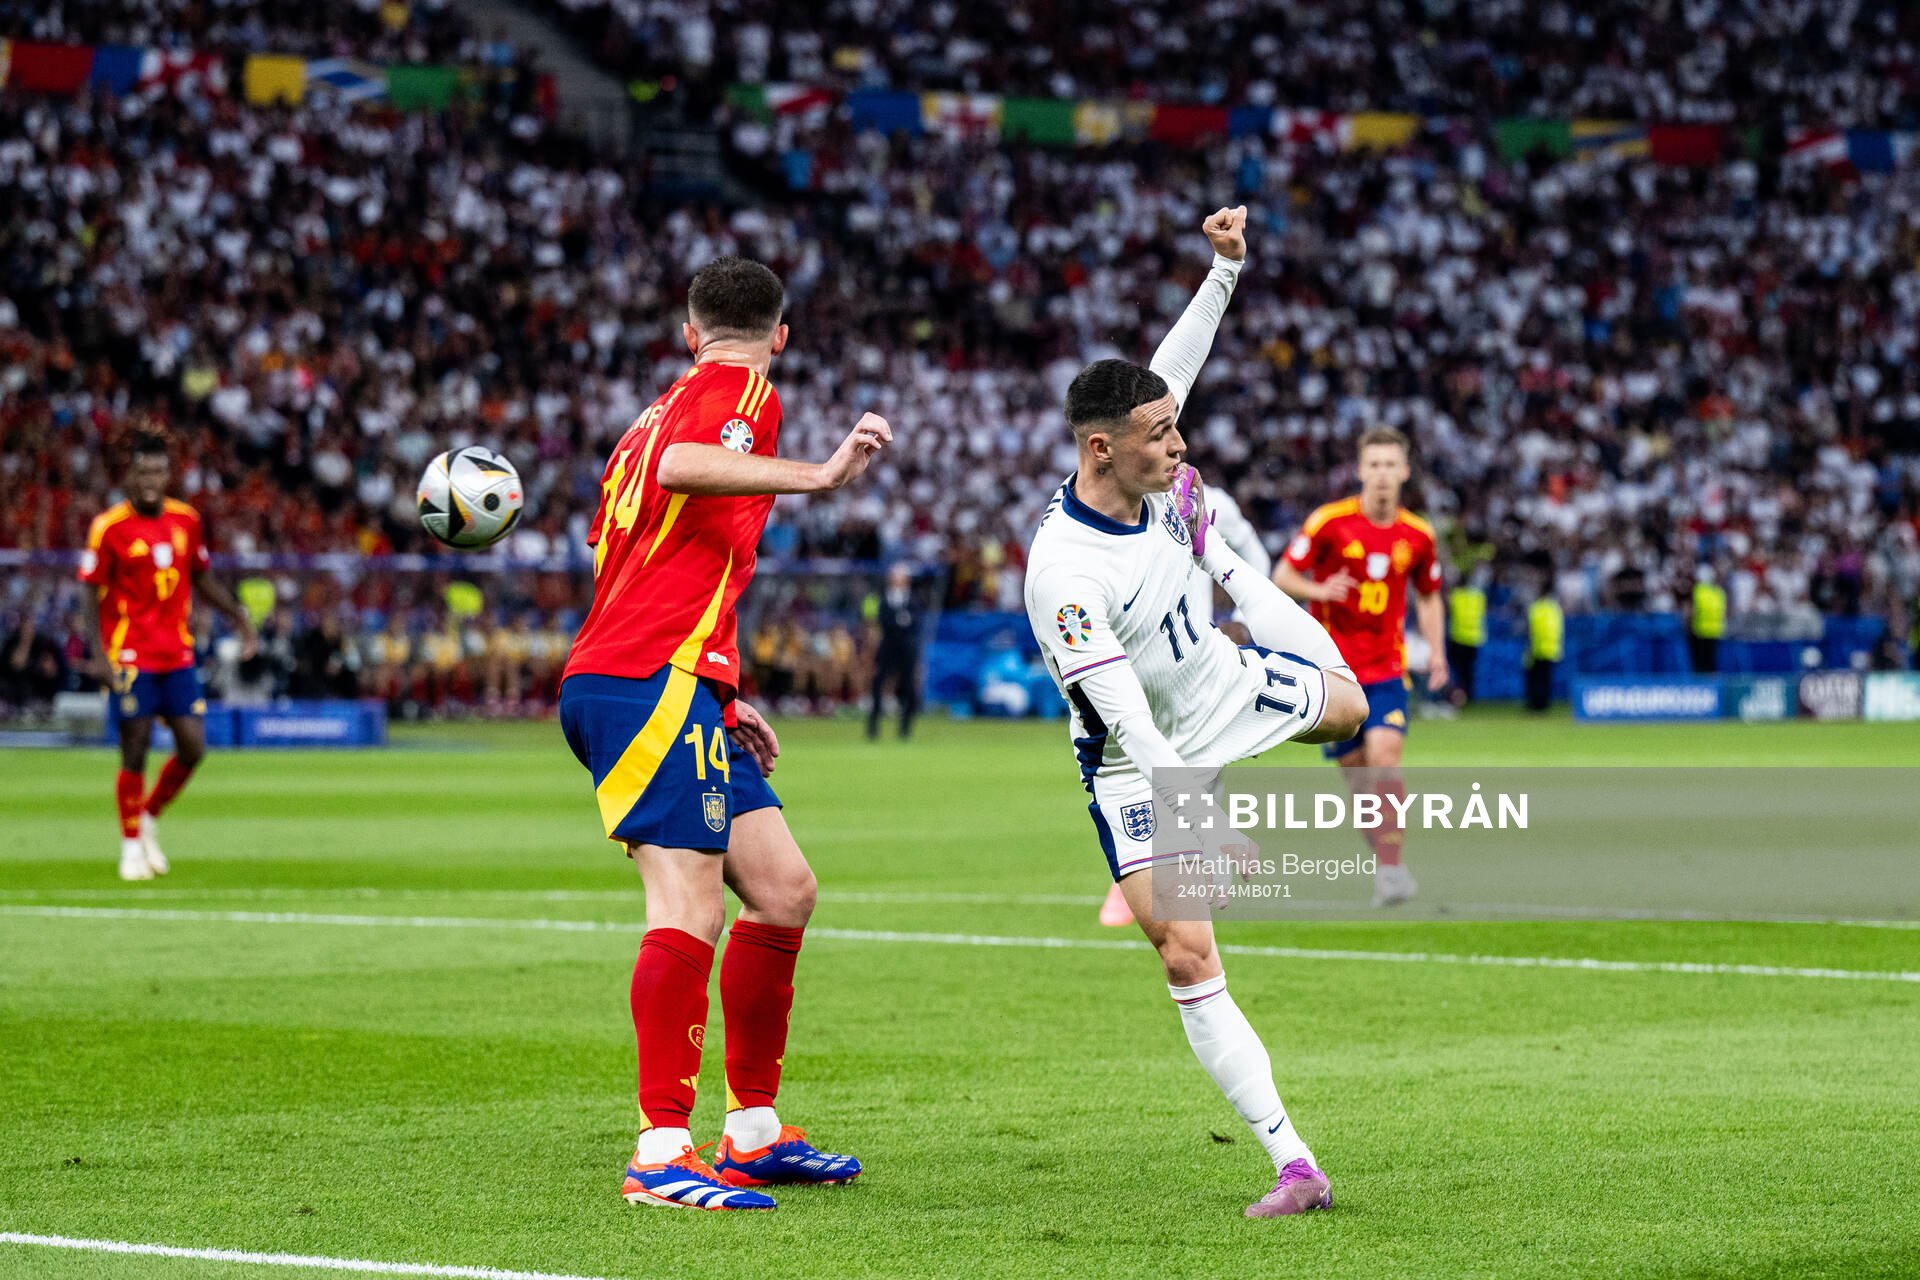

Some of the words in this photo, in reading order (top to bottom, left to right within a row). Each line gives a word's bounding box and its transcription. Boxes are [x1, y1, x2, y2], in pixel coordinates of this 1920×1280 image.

[596, 425, 661, 578] 14
[1159, 593, 1200, 663] 11
[1357, 580, 1389, 616] 10
[1254, 666, 1298, 715] 11
[684, 723, 730, 784] 14
